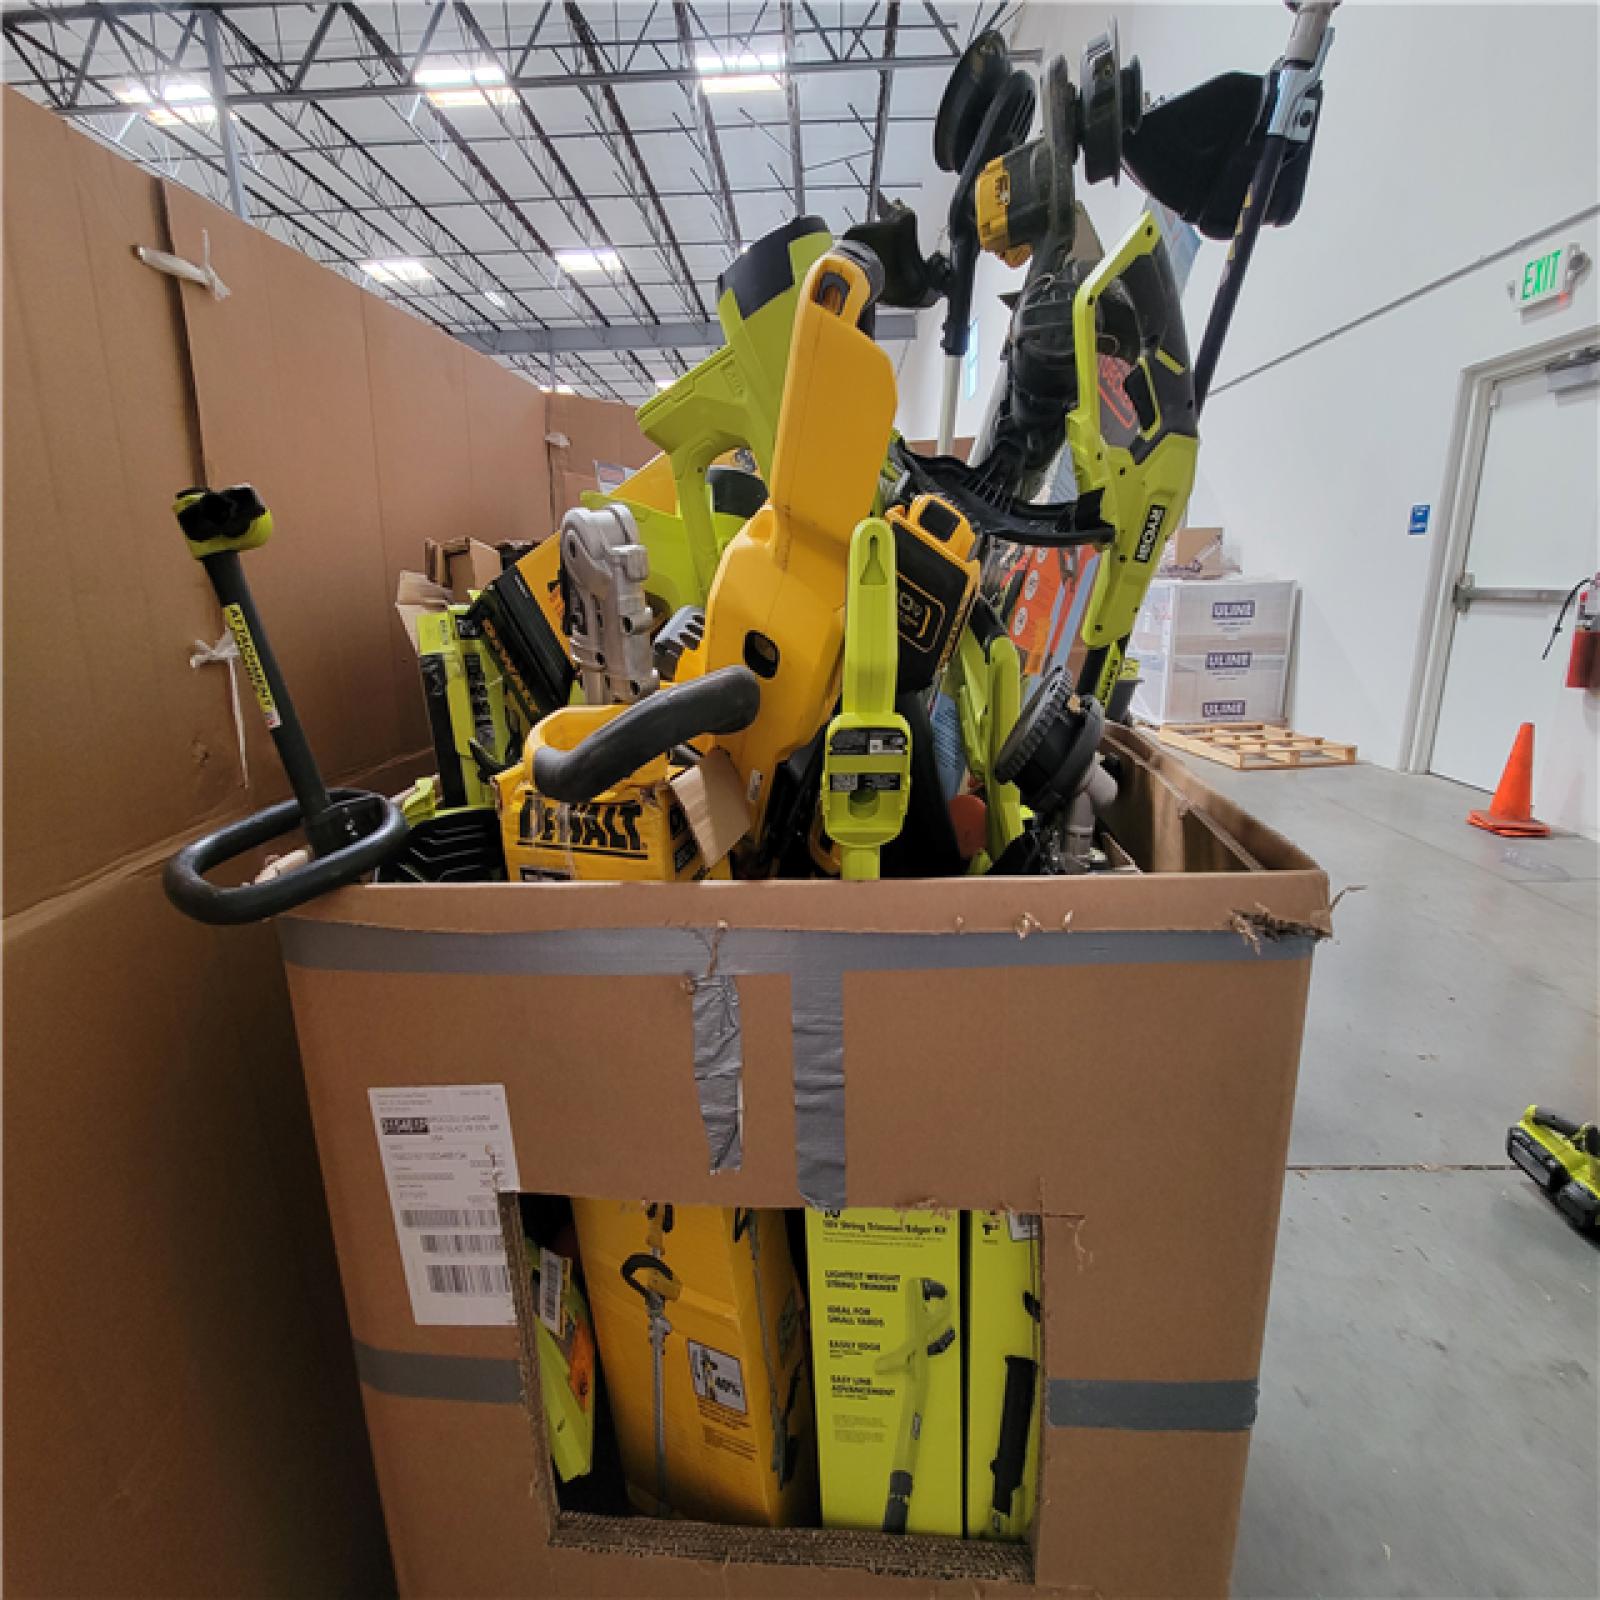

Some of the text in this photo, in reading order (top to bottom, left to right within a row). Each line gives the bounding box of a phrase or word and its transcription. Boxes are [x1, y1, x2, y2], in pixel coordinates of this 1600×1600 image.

[1521, 250, 1561, 300] EXIT
[1213, 603, 1252, 617] ULINE
[1208, 653, 1249, 667] ULINE
[1204, 703, 1242, 714] ULINE
[866, 1273, 900, 1282] WEIGHT
[859, 1283, 898, 1292] TRIMMER
[852, 1307, 870, 1316] FOR
